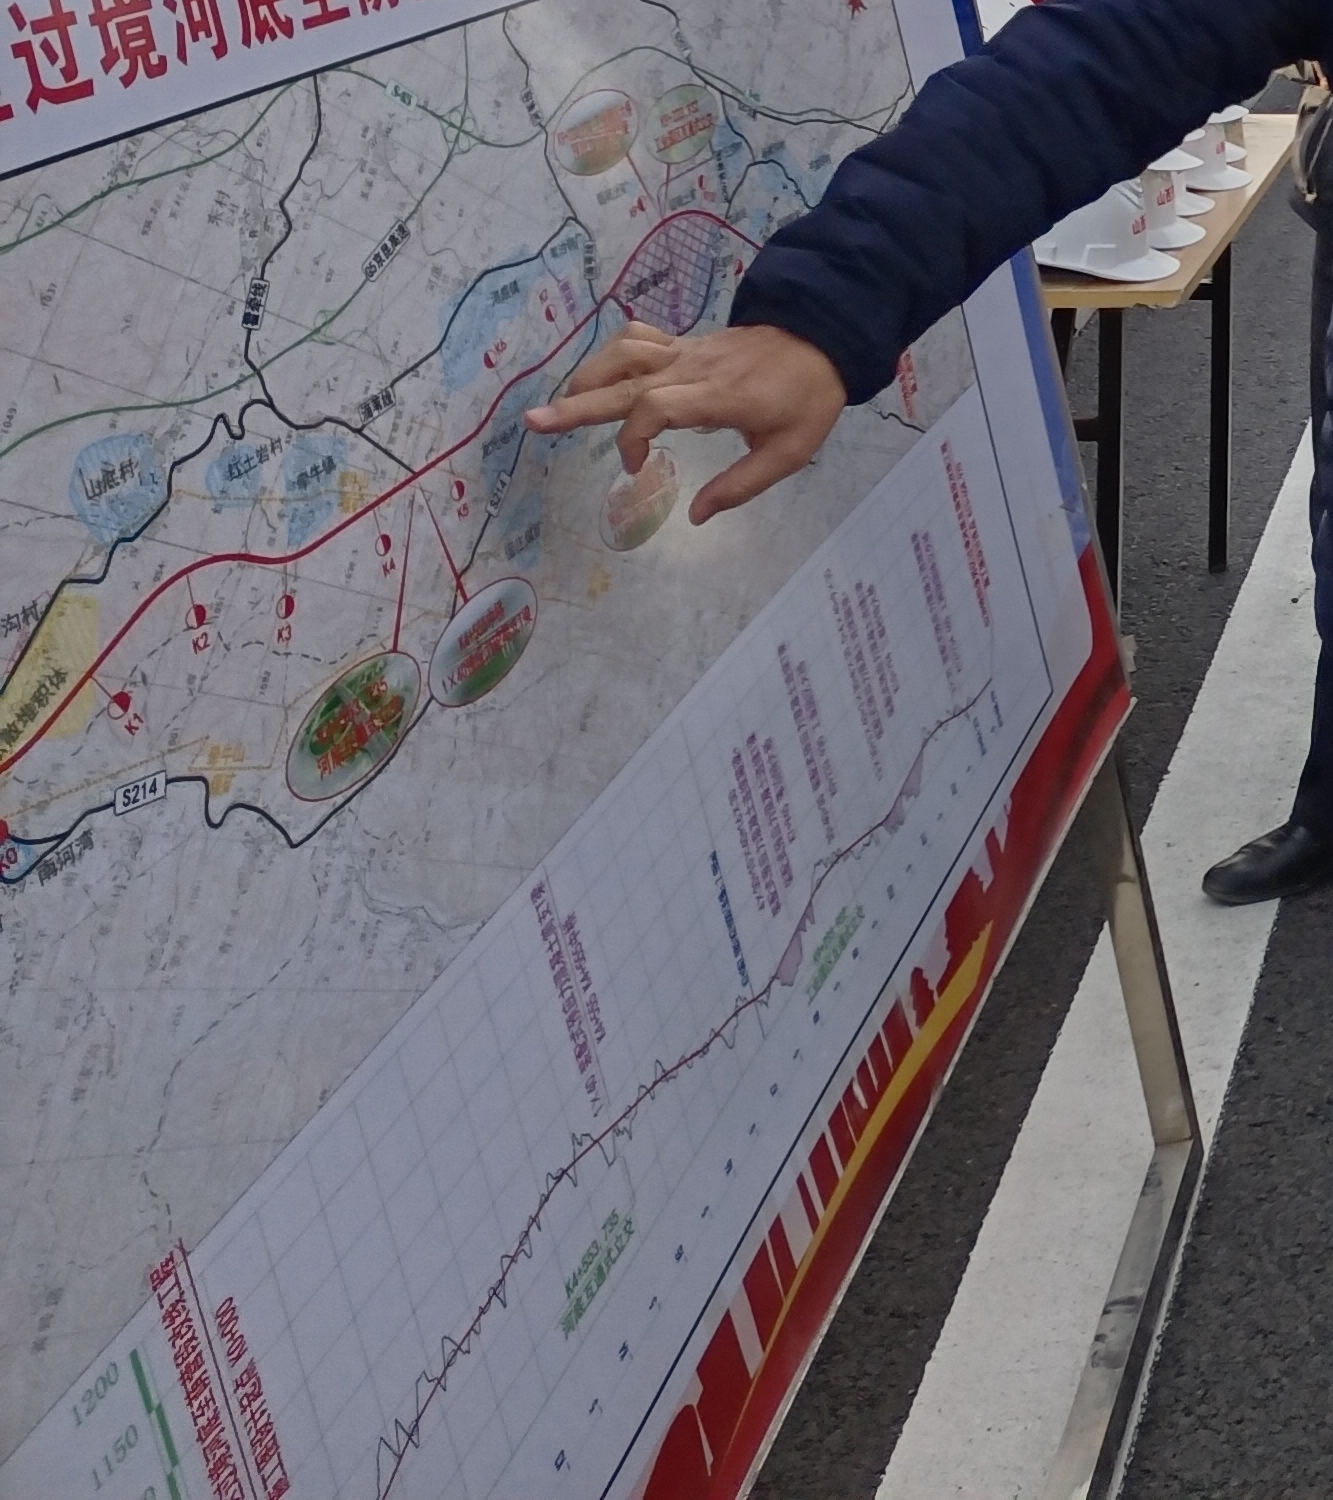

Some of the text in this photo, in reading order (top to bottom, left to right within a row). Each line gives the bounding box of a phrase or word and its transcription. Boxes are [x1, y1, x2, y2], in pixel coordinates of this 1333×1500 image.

[192, 632, 210, 655] K2
[277, 625, 293, 644] K3
[124, 712, 145, 736] K1
[121, 777, 158, 808] S214
